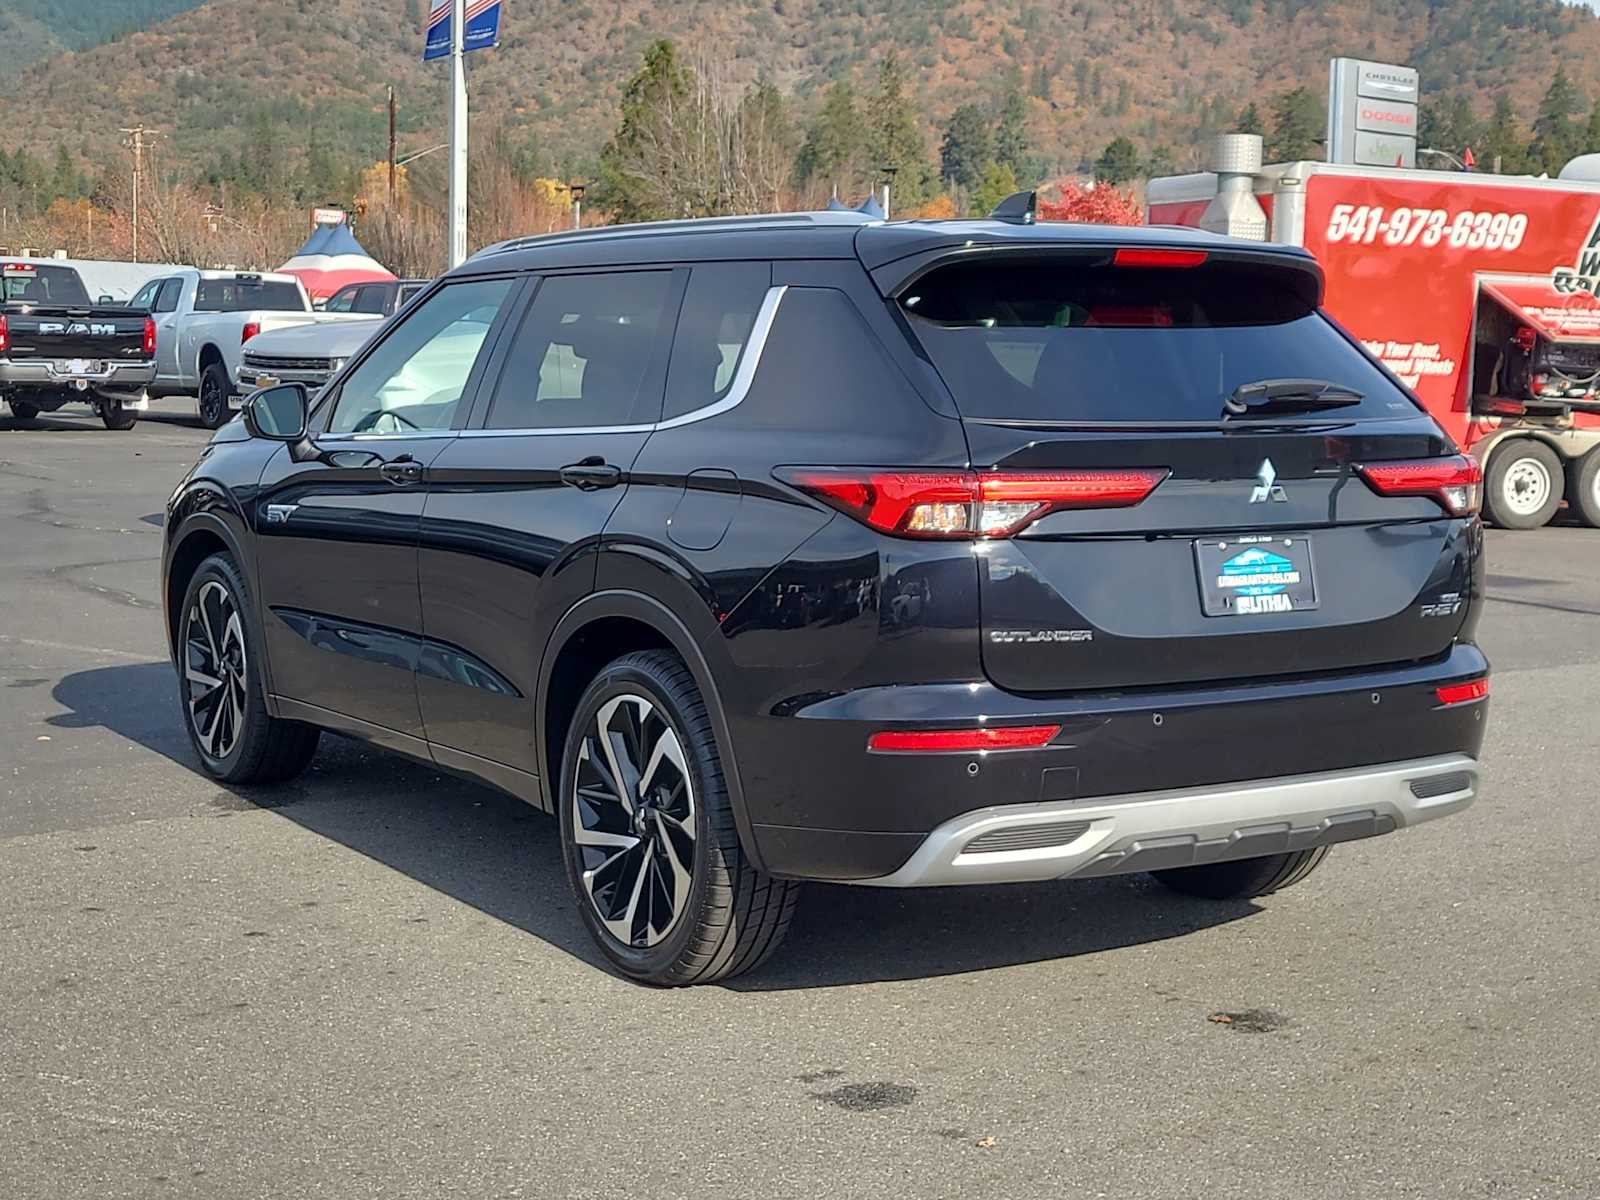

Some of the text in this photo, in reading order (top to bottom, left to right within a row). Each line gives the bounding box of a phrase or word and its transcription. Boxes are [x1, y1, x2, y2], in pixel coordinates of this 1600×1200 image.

[1365, 72, 1414, 84] CHRYSLER
[1361, 110, 1412, 125] DODGE
[1327, 204, 1528, 251] 541-973-6399
[39, 323, 115, 335] RAM
[1250, 593, 1293, 613] LITHIA
[1420, 602, 1461, 617] PHEV
[990, 631, 1093, 643] OUTLANDER
